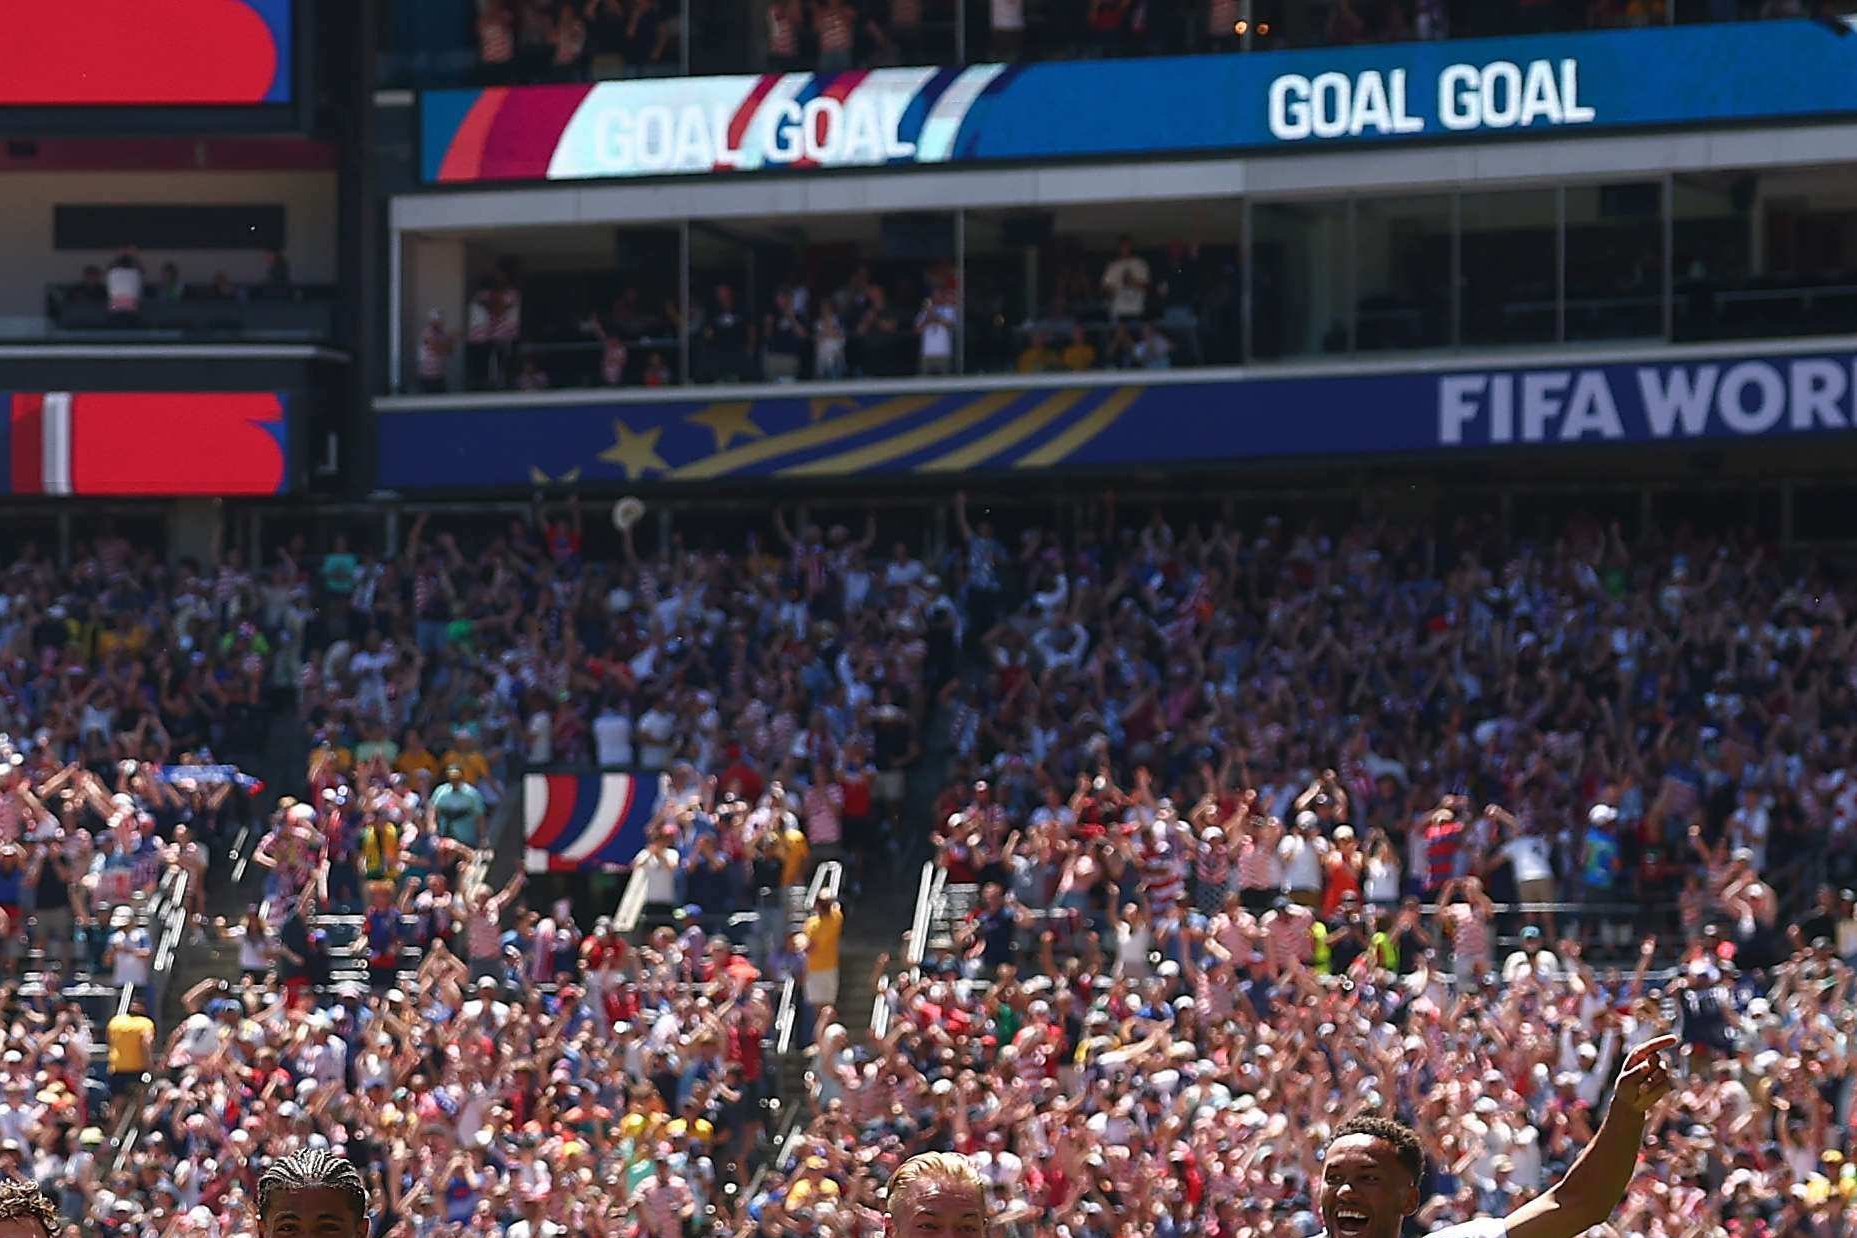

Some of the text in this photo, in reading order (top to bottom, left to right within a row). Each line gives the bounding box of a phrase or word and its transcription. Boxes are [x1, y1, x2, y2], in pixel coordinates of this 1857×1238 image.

[594, 95, 917, 169] GOAL GOAL
[1269, 58, 1596, 140] GOAL GOAL
[1437, 358, 1857, 442] FIFA WOR
